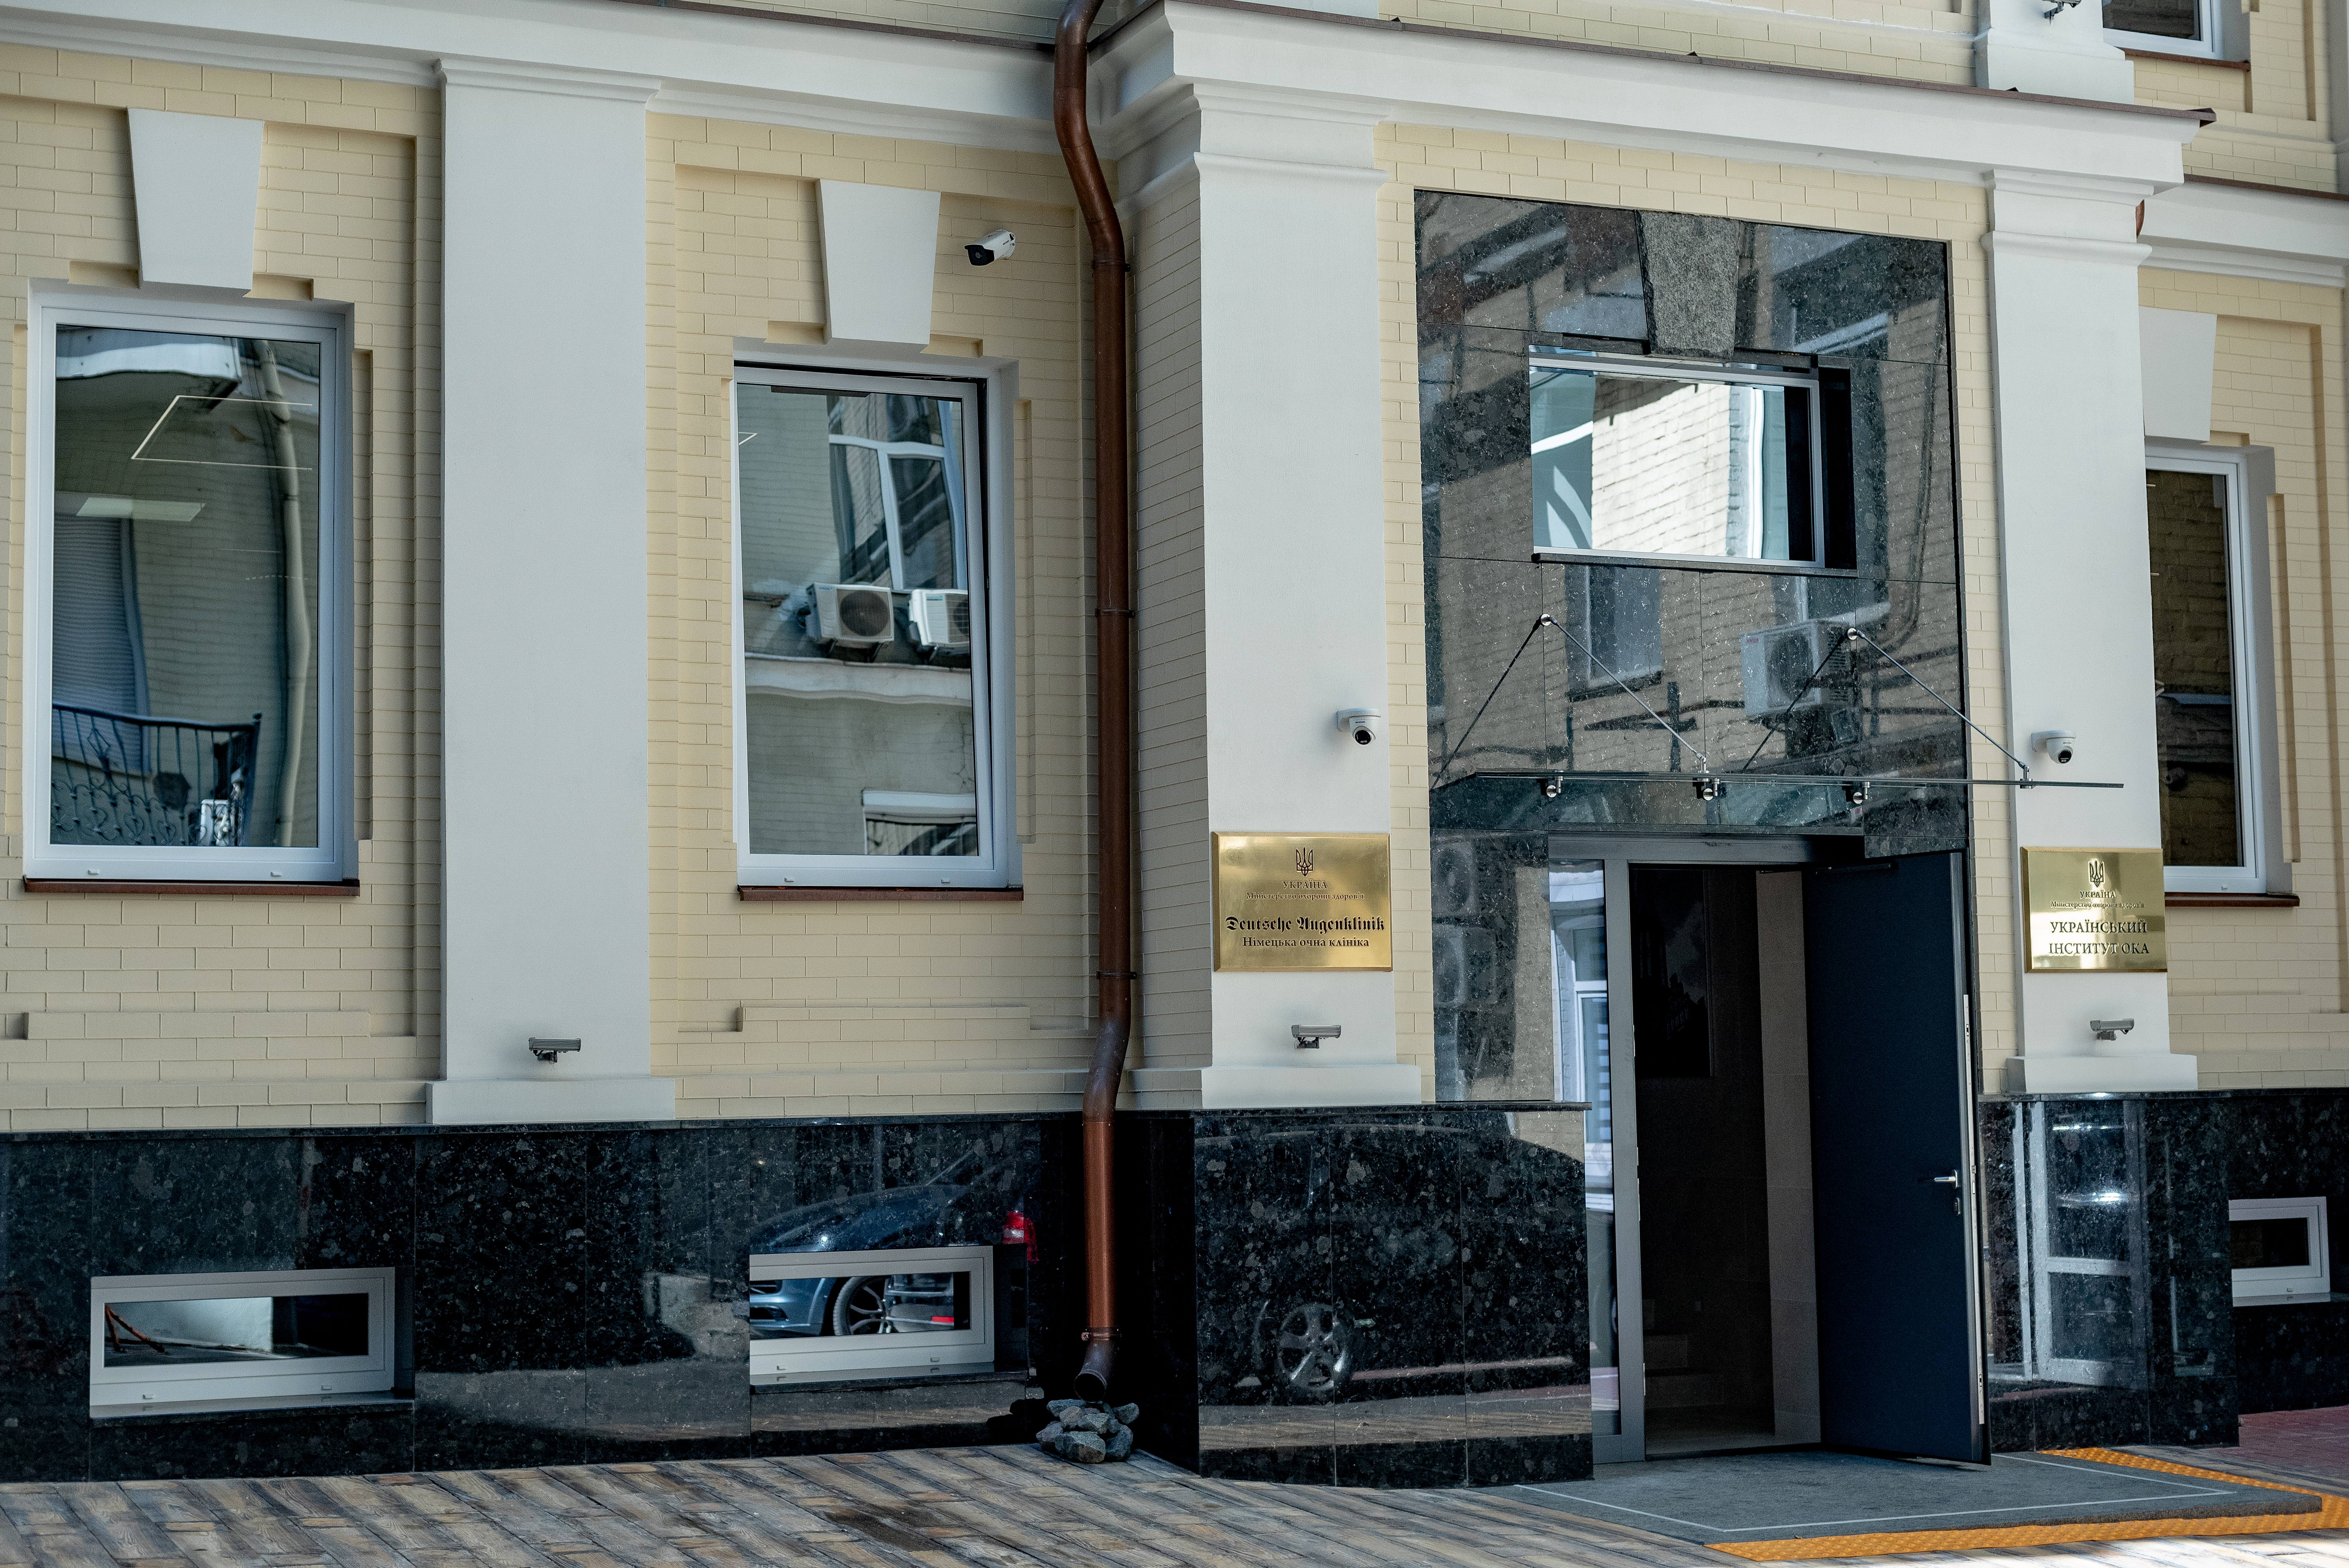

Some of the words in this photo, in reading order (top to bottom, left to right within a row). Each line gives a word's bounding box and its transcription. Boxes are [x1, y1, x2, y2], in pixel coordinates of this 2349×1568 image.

[1283, 880, 1328, 889] УКРАЇНА
[1225, 916, 1292, 933] Deutsche
[1296, 916, 1385, 934] Augenklinik
[2050, 919, 2148, 933] УКРАЇНСЬКИЙ
[1243, 937, 1297, 948] Німецька
[1329, 937, 1369, 947] клініка
[2049, 943, 2118, 954] ІНСТИТУТ
[2121, 943, 2150, 954] ОКА
